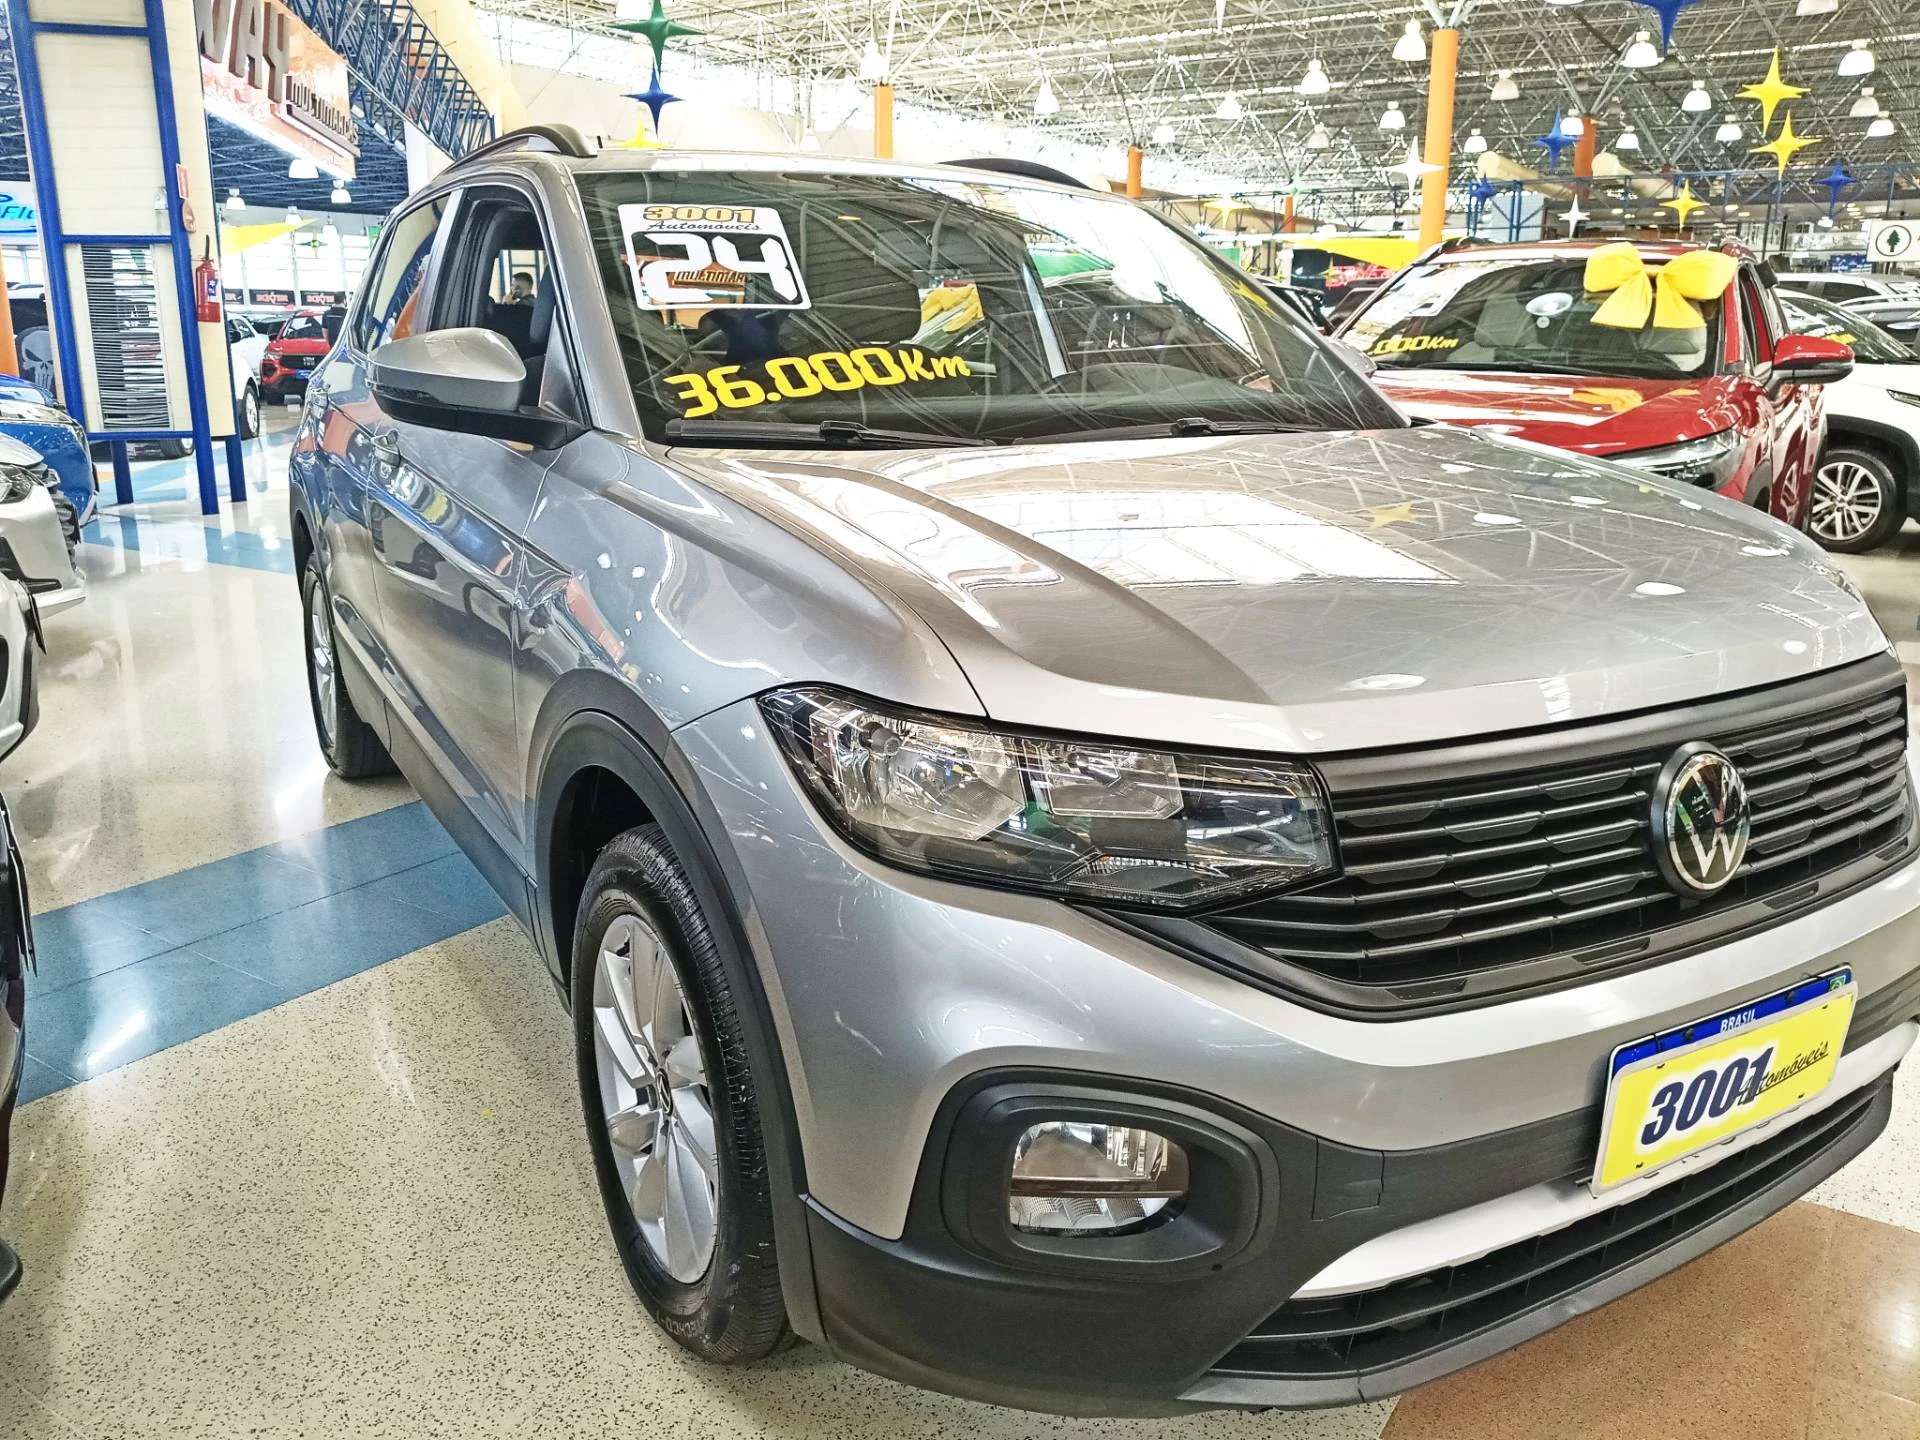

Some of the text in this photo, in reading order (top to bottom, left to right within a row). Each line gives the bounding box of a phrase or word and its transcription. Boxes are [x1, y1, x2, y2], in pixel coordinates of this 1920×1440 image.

[643, 206, 756, 224] 3001
[639, 232, 799, 303] 24
[1719, 1008, 1757, 1034] BRASIL
[1641, 1046, 1775, 1146] 3001
